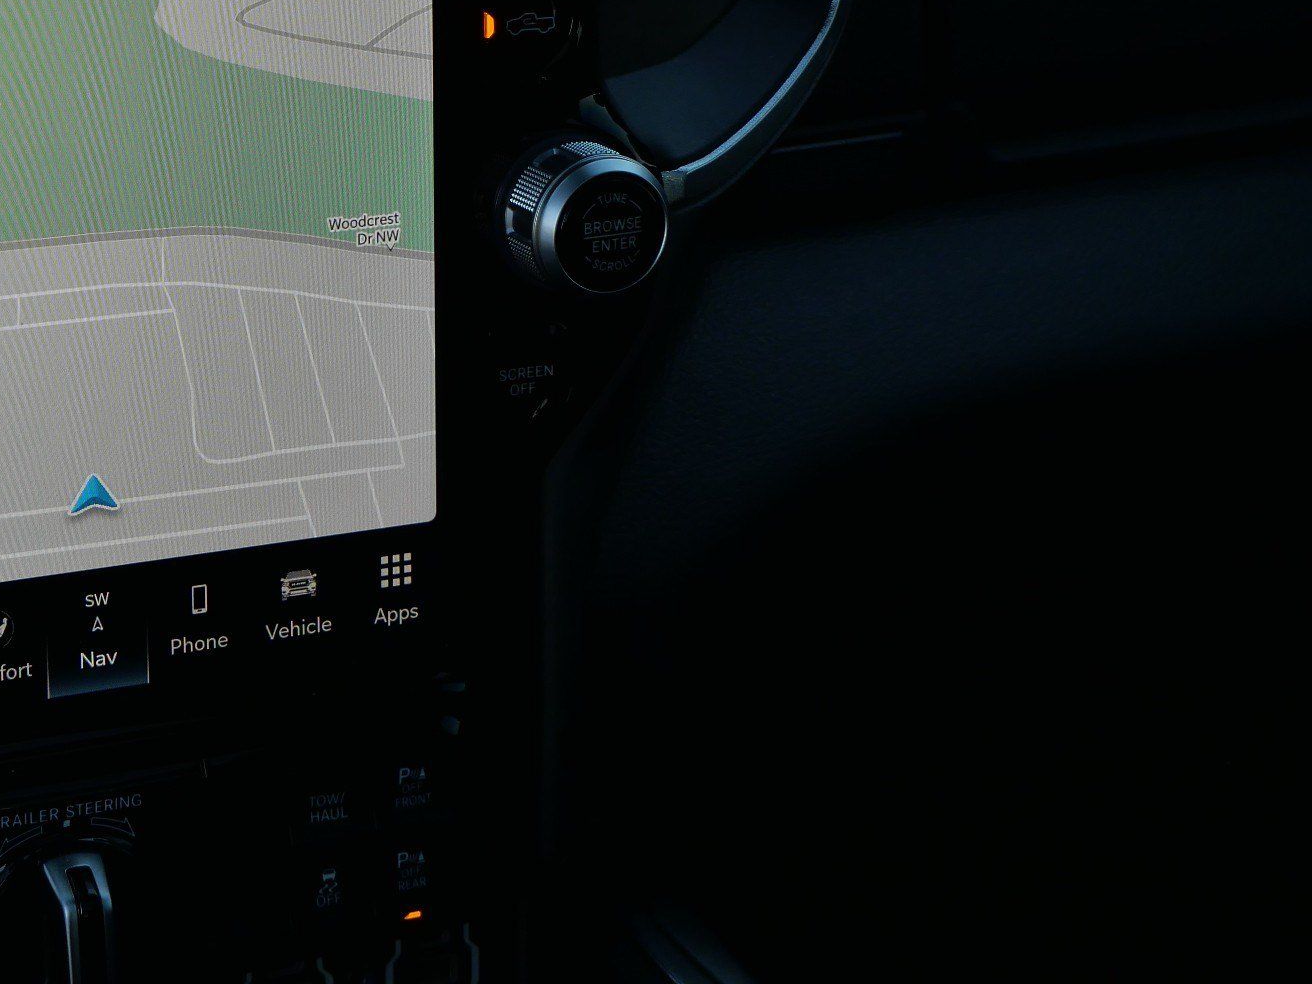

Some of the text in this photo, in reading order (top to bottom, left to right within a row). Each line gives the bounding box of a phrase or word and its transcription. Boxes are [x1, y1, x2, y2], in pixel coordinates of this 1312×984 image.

[329, 213, 399, 231] Woodcrest
[584, 216, 642, 235] BROWSE
[357, 229, 399, 246] Dr NW
[592, 236, 638, 253] ENTER
[499, 365, 554, 382] SCREEN
[510, 381, 536, 396] OFF
[85, 592, 110, 607] SW
[374, 605, 419, 627] Apps
[265, 616, 333, 641] Vehicle
[171, 634, 229, 656] Phone
[80, 651, 118, 670] Nav
[66, 793, 142, 818] STEERING
[310, 806, 349, 823] HAUL
